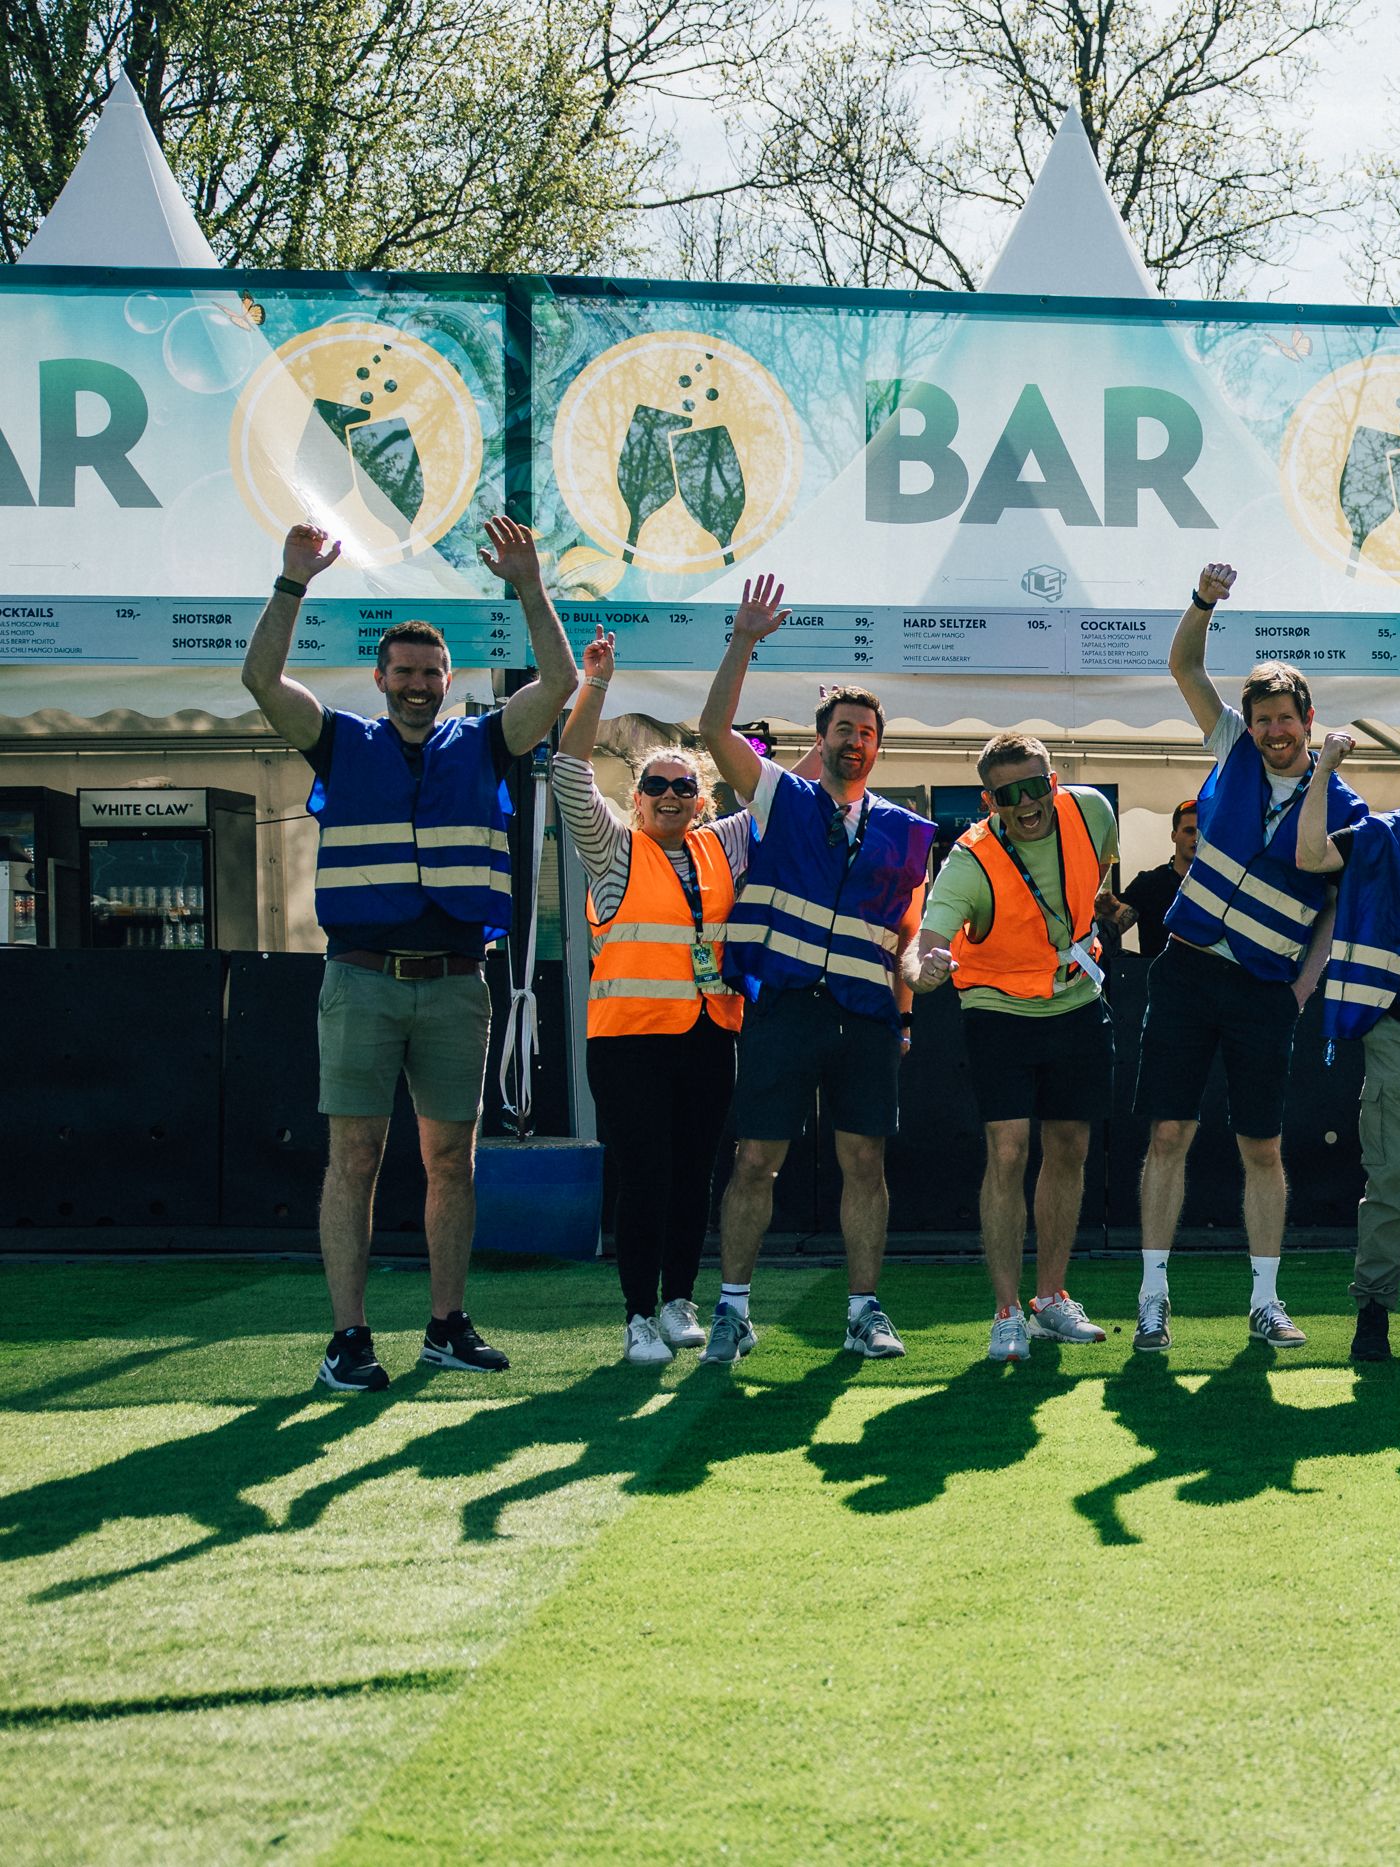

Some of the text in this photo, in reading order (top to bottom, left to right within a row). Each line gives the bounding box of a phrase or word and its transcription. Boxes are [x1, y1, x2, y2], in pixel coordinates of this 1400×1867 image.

[0, 358, 163, 508] R
[865, 378, 1220, 529] BAR
[0, 608, 141, 620] CKTAILS 129,-
[359, 610, 510, 623] VANN 39,-
[574, 614, 602, 623] BULL
[606, 614, 649, 623] VODKA
[670, 614, 693, 624] 129,-
[172, 614, 326, 627] SHOTSRØR 55,-
[790, 617, 823, 626] LAGER
[856, 618, 874, 628] 99,-
[904, 619, 1052, 631] HARD SELTZER 105,-
[1081, 622, 1226, 632] COCKTAILS 29,-
[1255, 627, 1396, 638] SHOTSRØR 55,-
[490, 630, 510, 641] 49,-
[855, 636, 873, 646] 99,-
[172, 638, 325, 650] SHOTSRØR 10 550,-
[490, 648, 510, 659] 49,-
[855, 653, 873, 663] 99,-
[1256, 650, 1397, 661] SHOTSRØR 10 STK 550,-
[92, 804, 142, 816] WHITE
